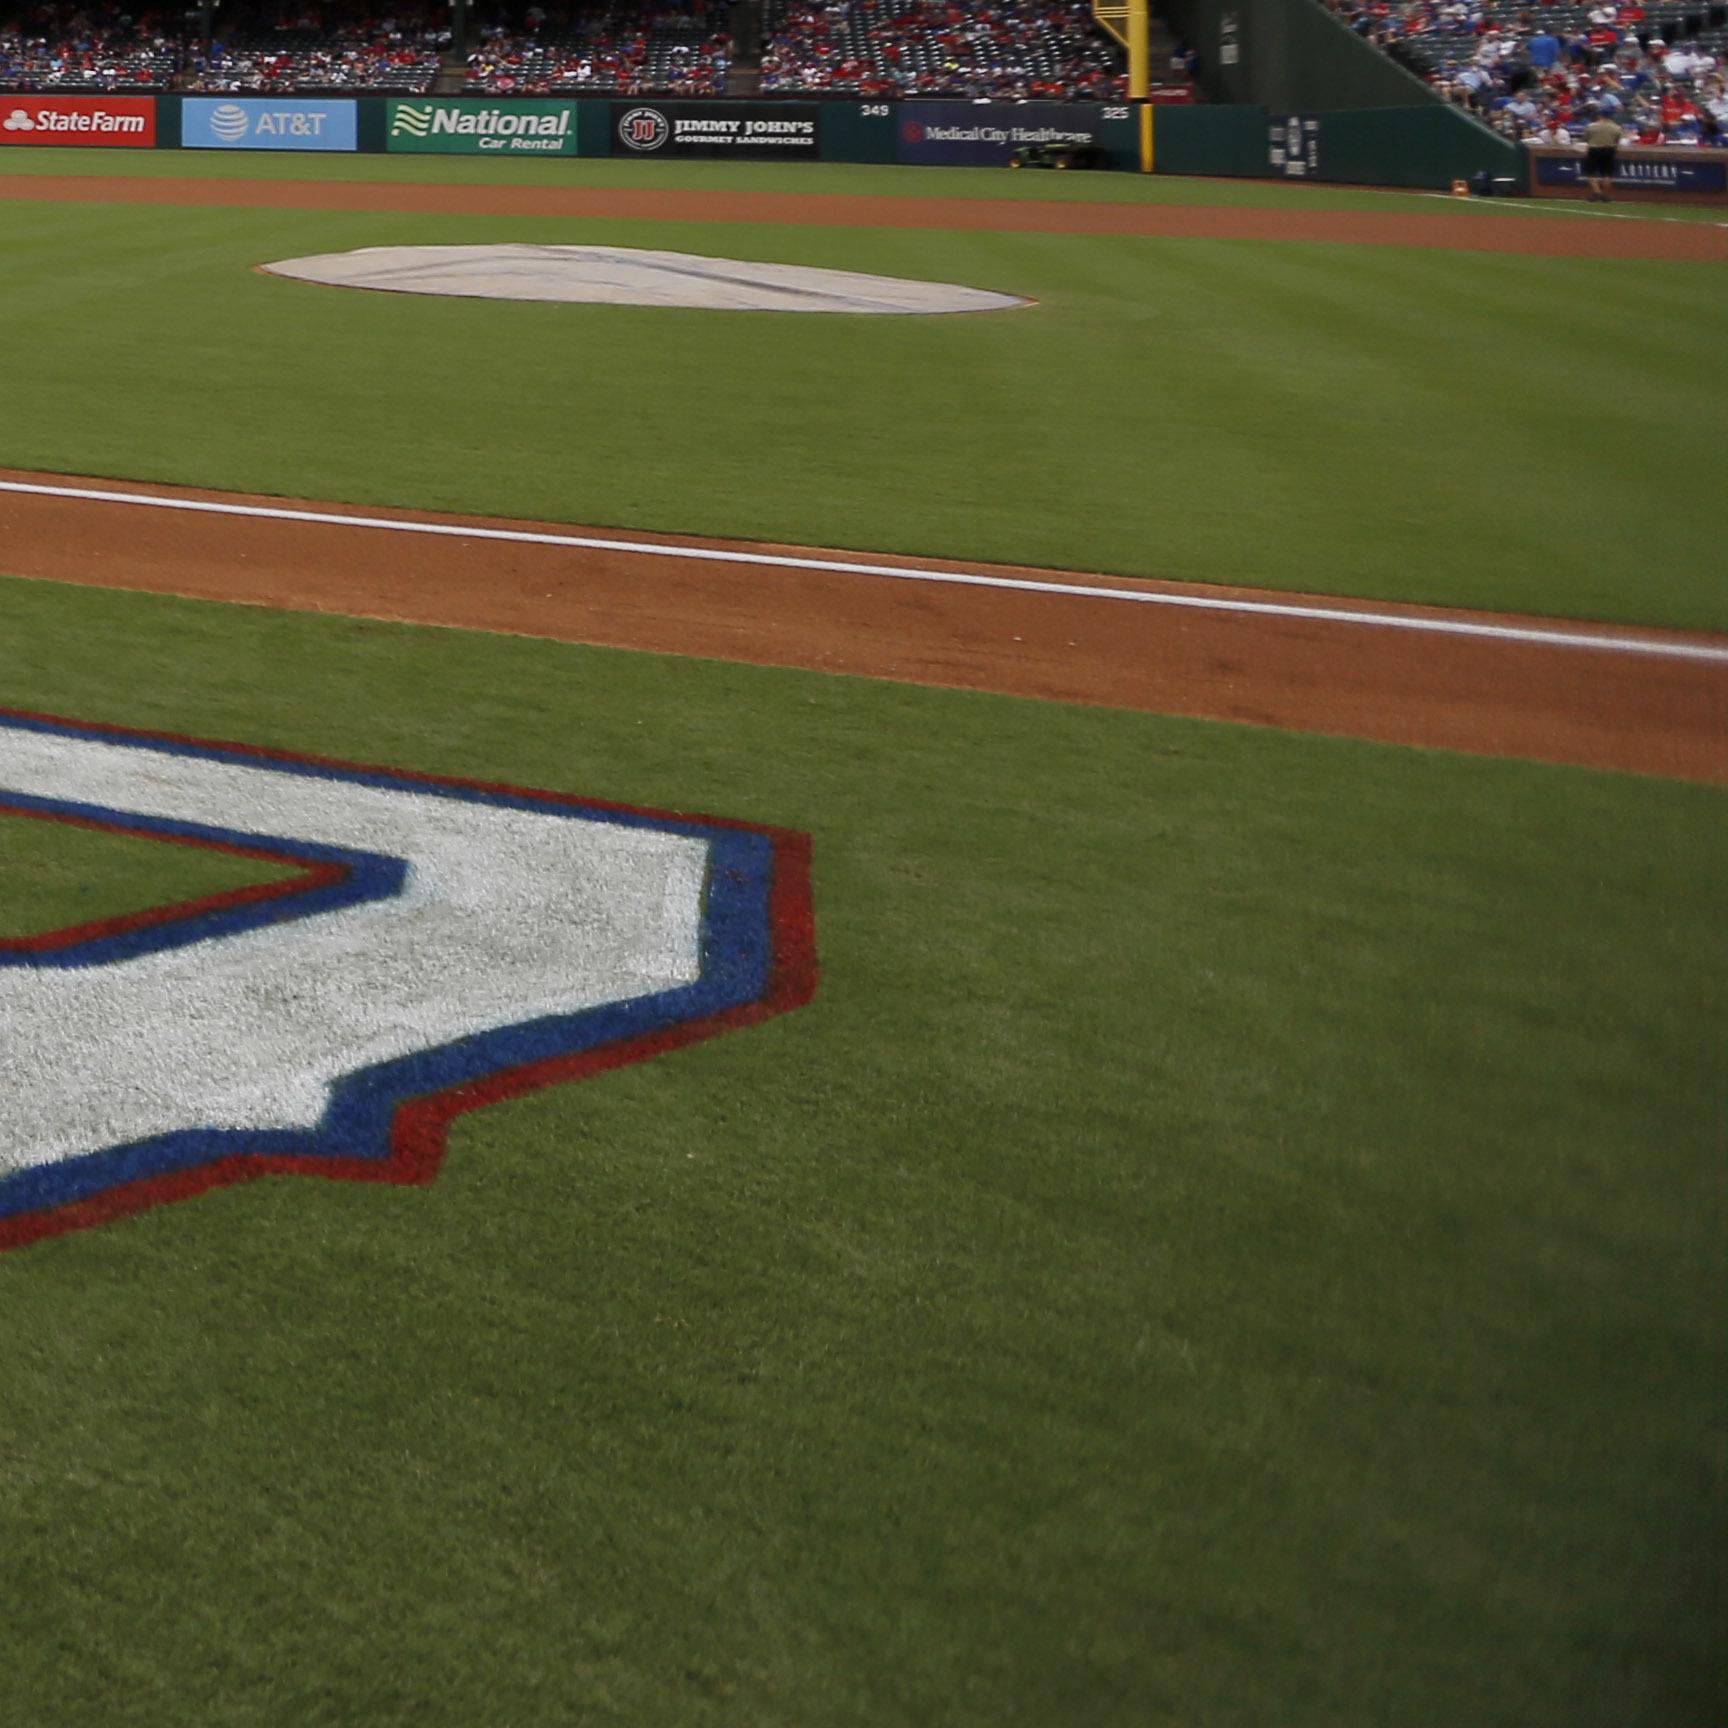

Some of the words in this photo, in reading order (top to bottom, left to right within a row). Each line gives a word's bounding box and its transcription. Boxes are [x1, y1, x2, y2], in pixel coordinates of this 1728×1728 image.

[860, 104, 890, 117] 349
[1101, 106, 1130, 120] 325
[255, 112, 328, 136] AT&T
[431, 108, 571, 136] National
[675, 119, 741, 134] JIMMY
[744, 121, 814, 135] JOHN'S
[675, 134, 735, 144] GOURMET
[735, 135, 814, 146] SANDWICHES
[925, 126, 980, 141] Medical
[980, 127, 1010, 145] City
[1011, 127, 1093, 144] Healthcare
[478, 137, 506, 150] Car
[510, 138, 564, 150] Rental
